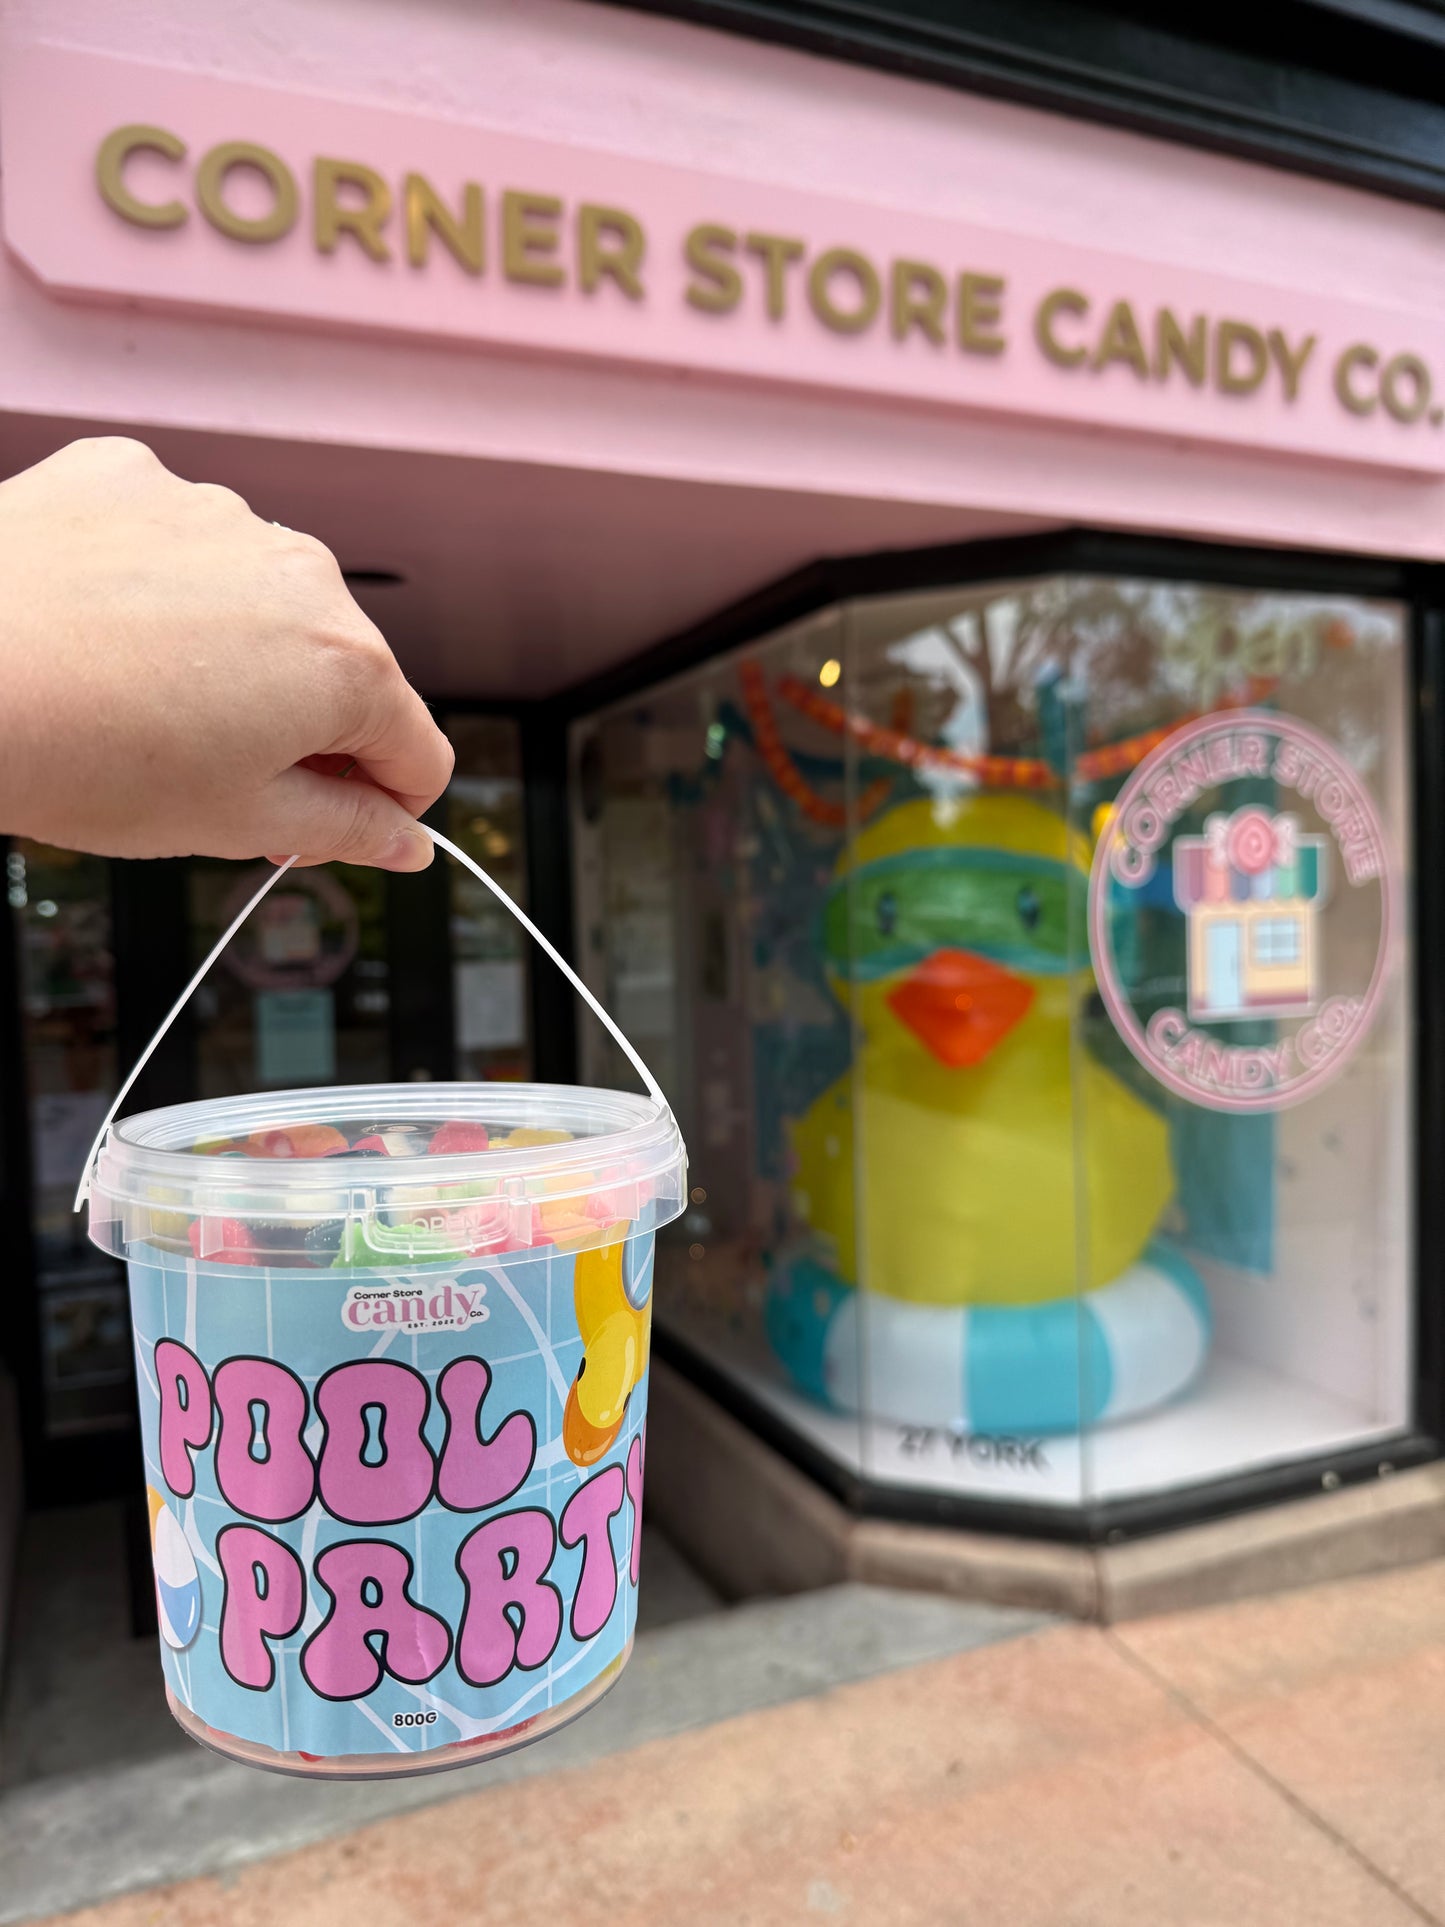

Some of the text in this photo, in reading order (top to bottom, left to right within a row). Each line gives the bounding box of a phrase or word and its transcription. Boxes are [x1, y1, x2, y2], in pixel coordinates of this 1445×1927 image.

[95, 123, 1444, 426] CORNER STORE CANDY CO.
[1111, 733, 1383, 888] CORNER STORE
[1146, 1006, 1292, 1090] CANDY
[412, 1213, 480, 1234] OPEN
[348, 1285, 480, 1325] candy
[354, 1289, 423, 1300] Corner Store
[154, 1336, 538, 1527] POOL
[898, 1426, 1050, 1470] 27 YORK
[394, 1711, 437, 1726] 800G
